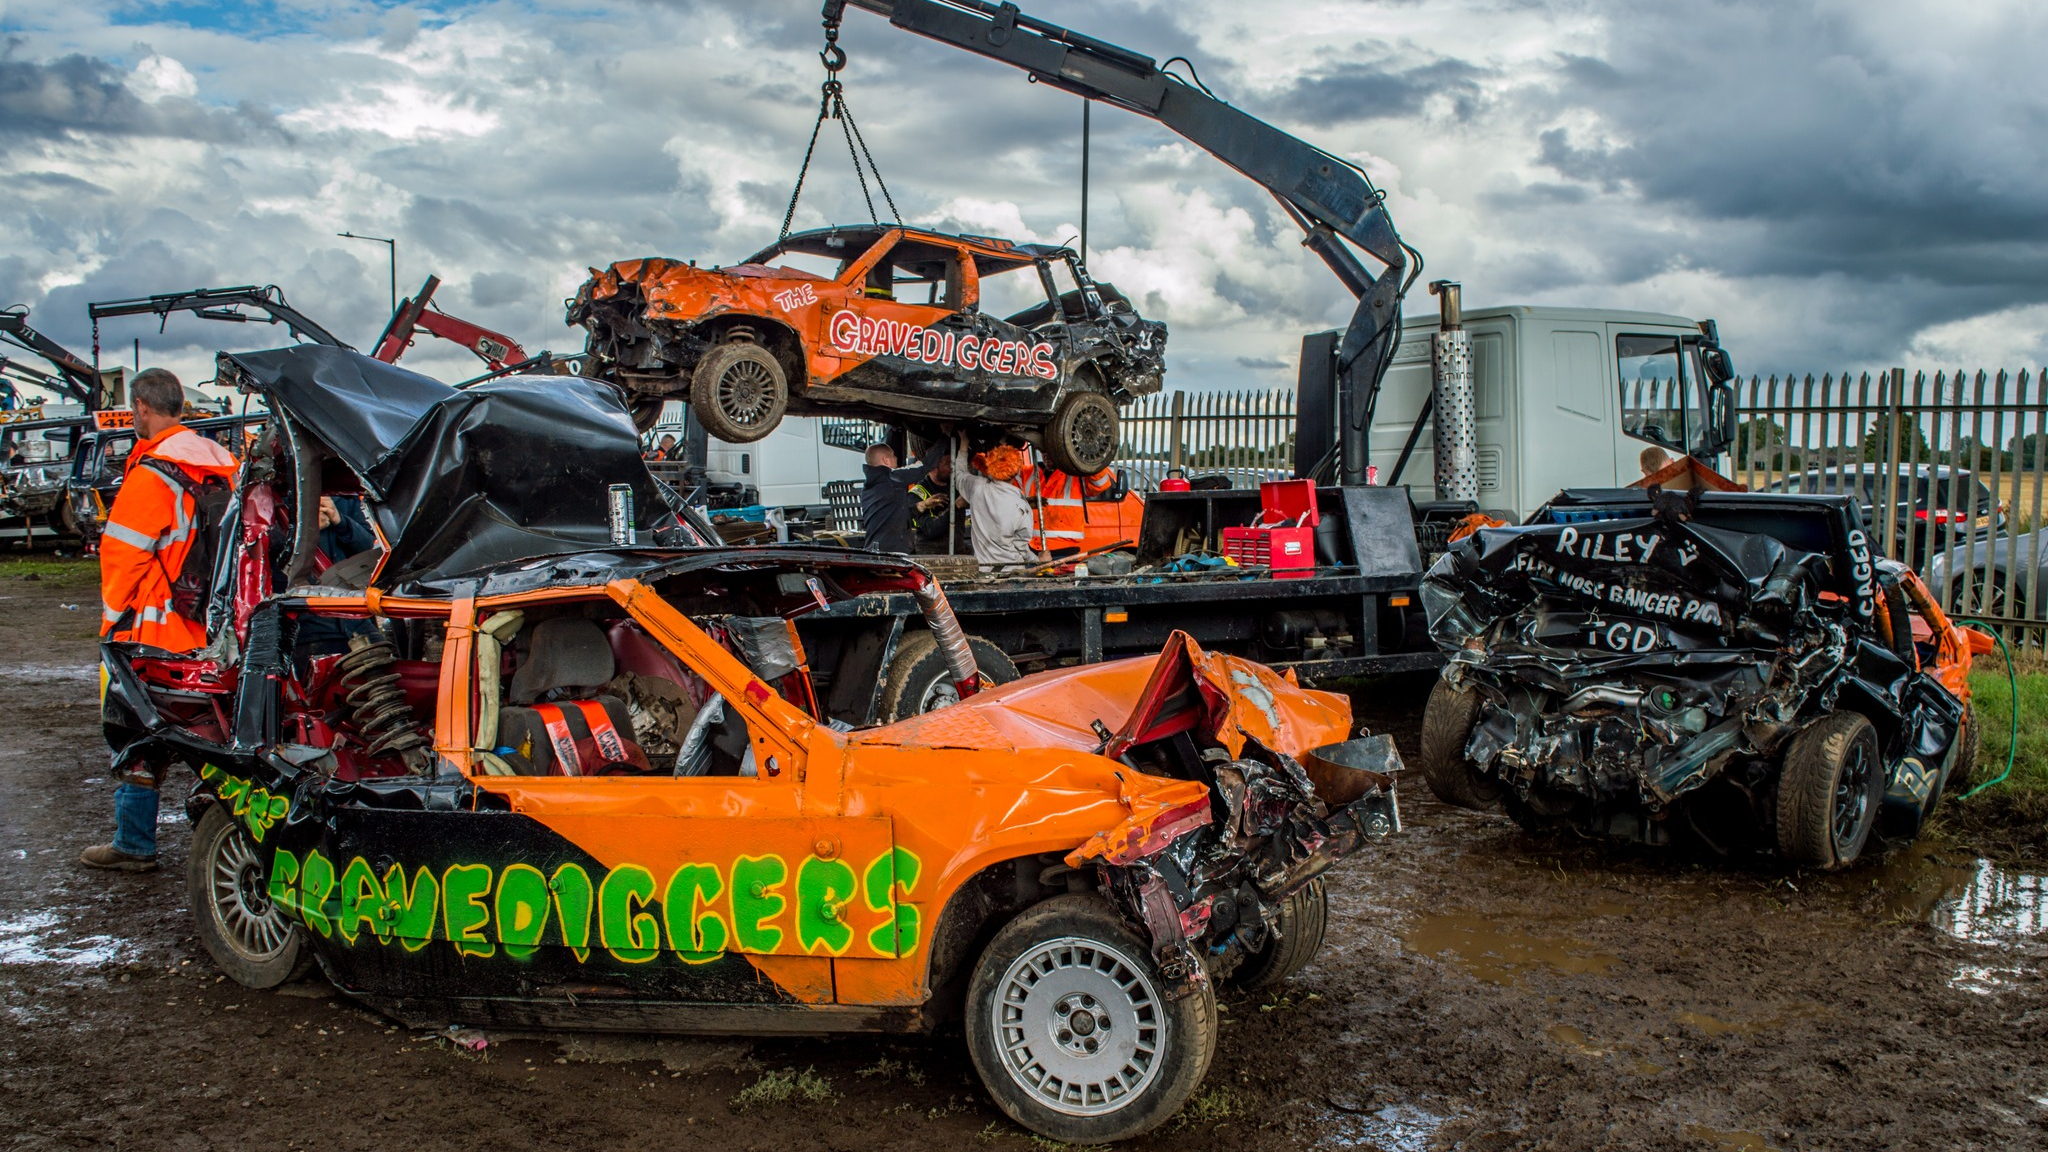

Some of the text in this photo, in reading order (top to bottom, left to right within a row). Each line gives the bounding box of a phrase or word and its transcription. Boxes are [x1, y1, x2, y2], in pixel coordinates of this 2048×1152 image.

[773, 283, 818, 313] THE
[1069, 255, 1102, 303] ALFIE
[829, 309, 1058, 380] GRAVEDIGGERS
[1555, 526, 1661, 564] RILEY
[1848, 529, 1875, 617] CAGED
[1608, 585, 1679, 618] BANGER
[266, 845, 923, 966] GRAVEDIGGERS
